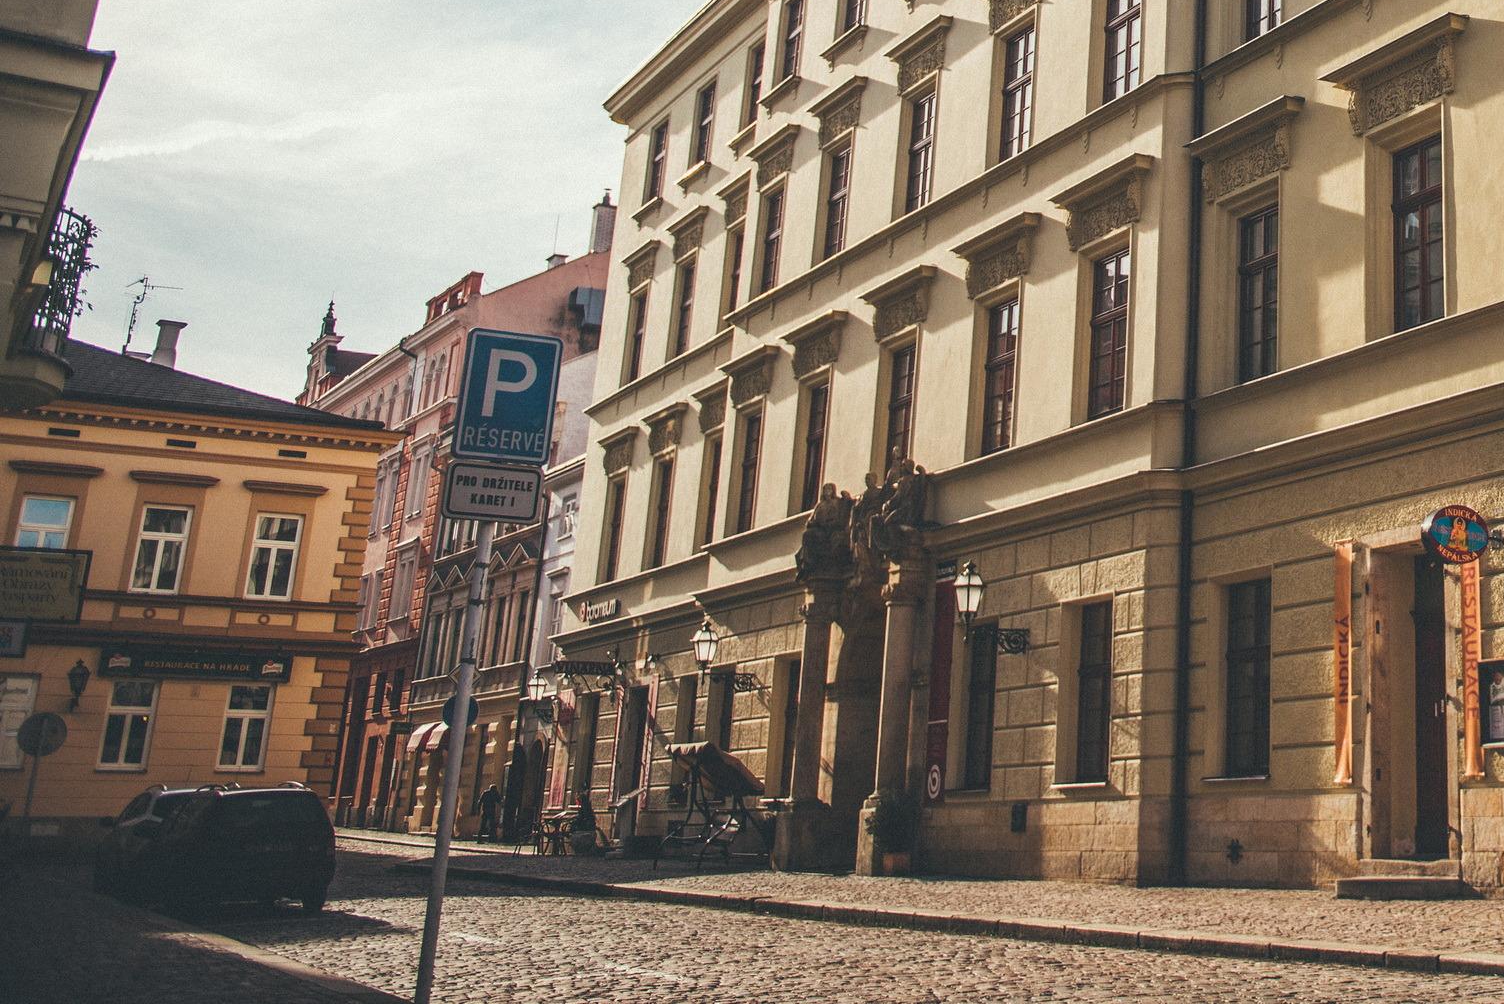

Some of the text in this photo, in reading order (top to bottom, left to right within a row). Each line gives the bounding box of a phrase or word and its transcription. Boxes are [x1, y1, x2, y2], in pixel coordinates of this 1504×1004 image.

[481, 348, 538, 417] P
[463, 424, 545, 453] RÉSERVÉ
[455, 474, 534, 493] PRO DRŽITELE
[470, 493, 506, 508] KARET
[1335, 613, 1350, 705] INDICKÁ
[1463, 565, 1479, 720] RESTAURACE
